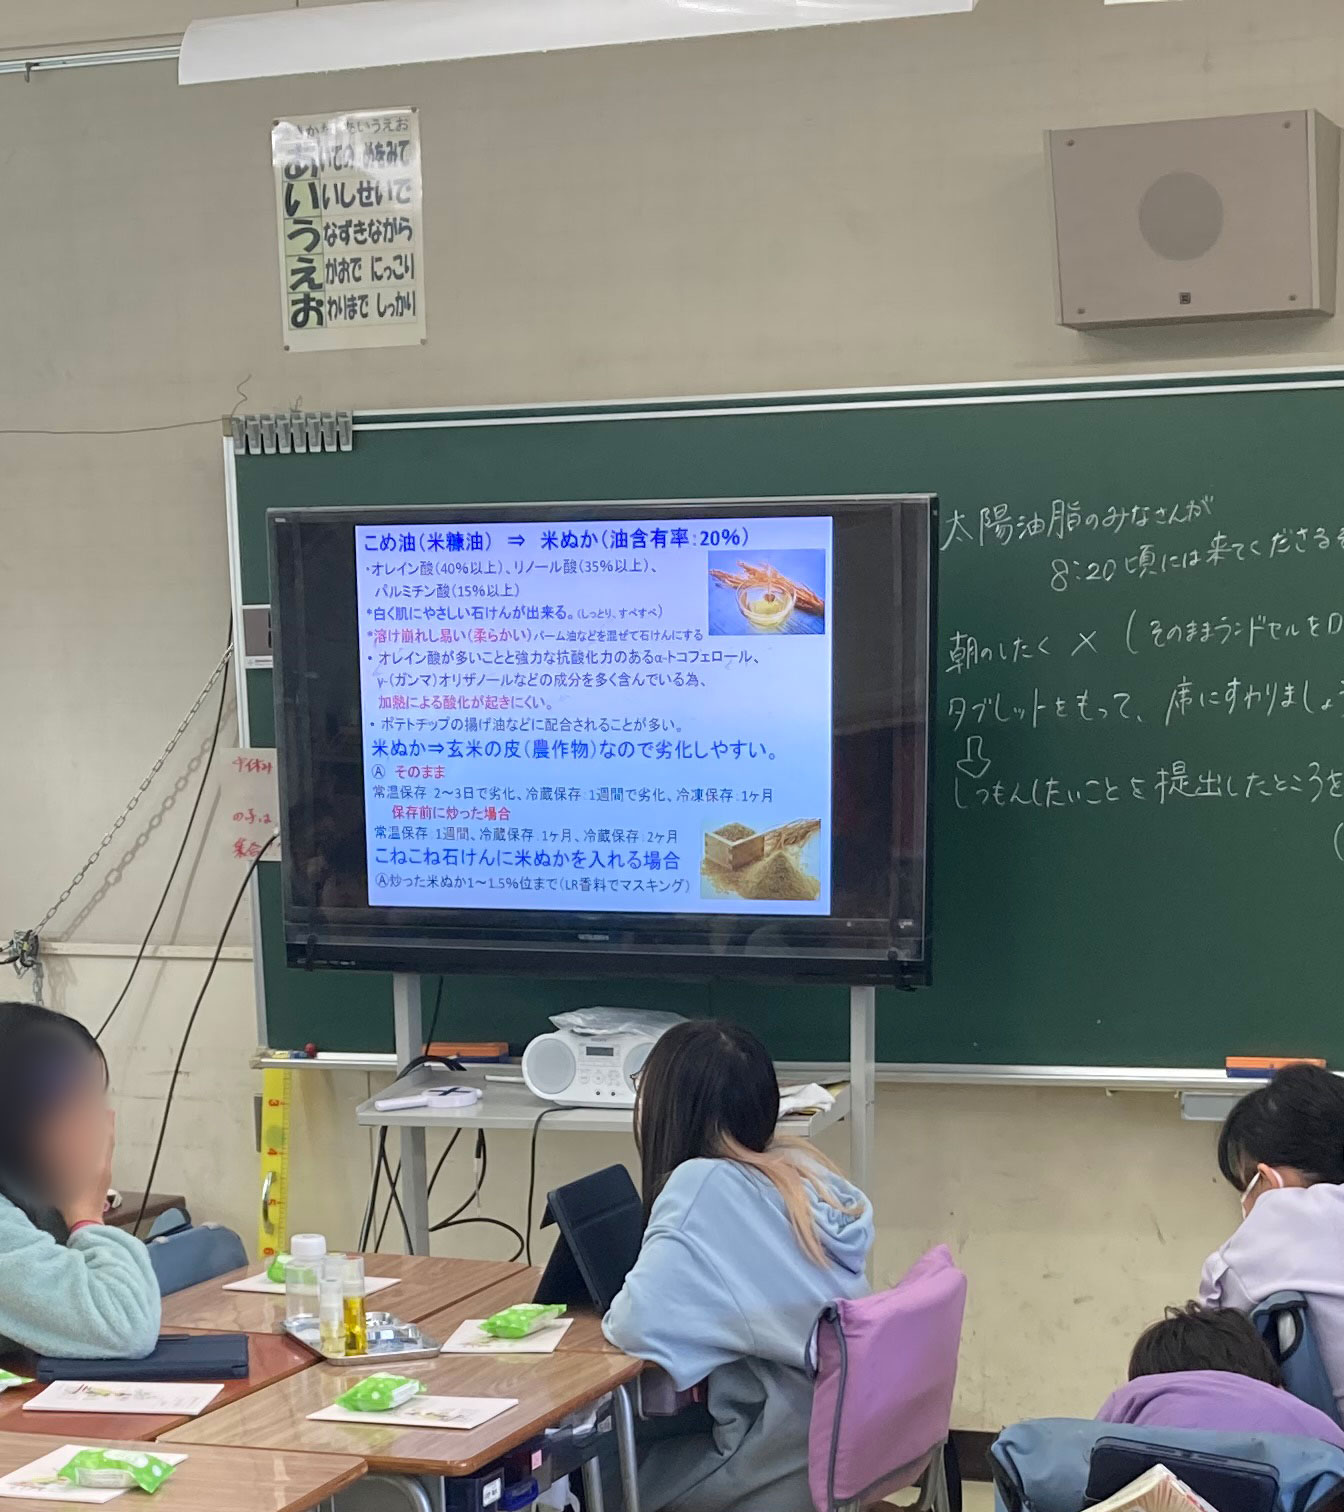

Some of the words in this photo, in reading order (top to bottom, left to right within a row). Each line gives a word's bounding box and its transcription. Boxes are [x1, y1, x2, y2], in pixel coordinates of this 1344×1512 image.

[370, 252, 415, 283] にっこり
[376, 290, 417, 318] しっかり
[940, 495, 1214, 551] 太陽油脂のみなさんが
[946, 631, 1052, 674] 朝のしたく
[394, 764, 446, 780] そのまま
[375, 847, 681, 871] こねこね石けんに米ぬかを入れる場合
